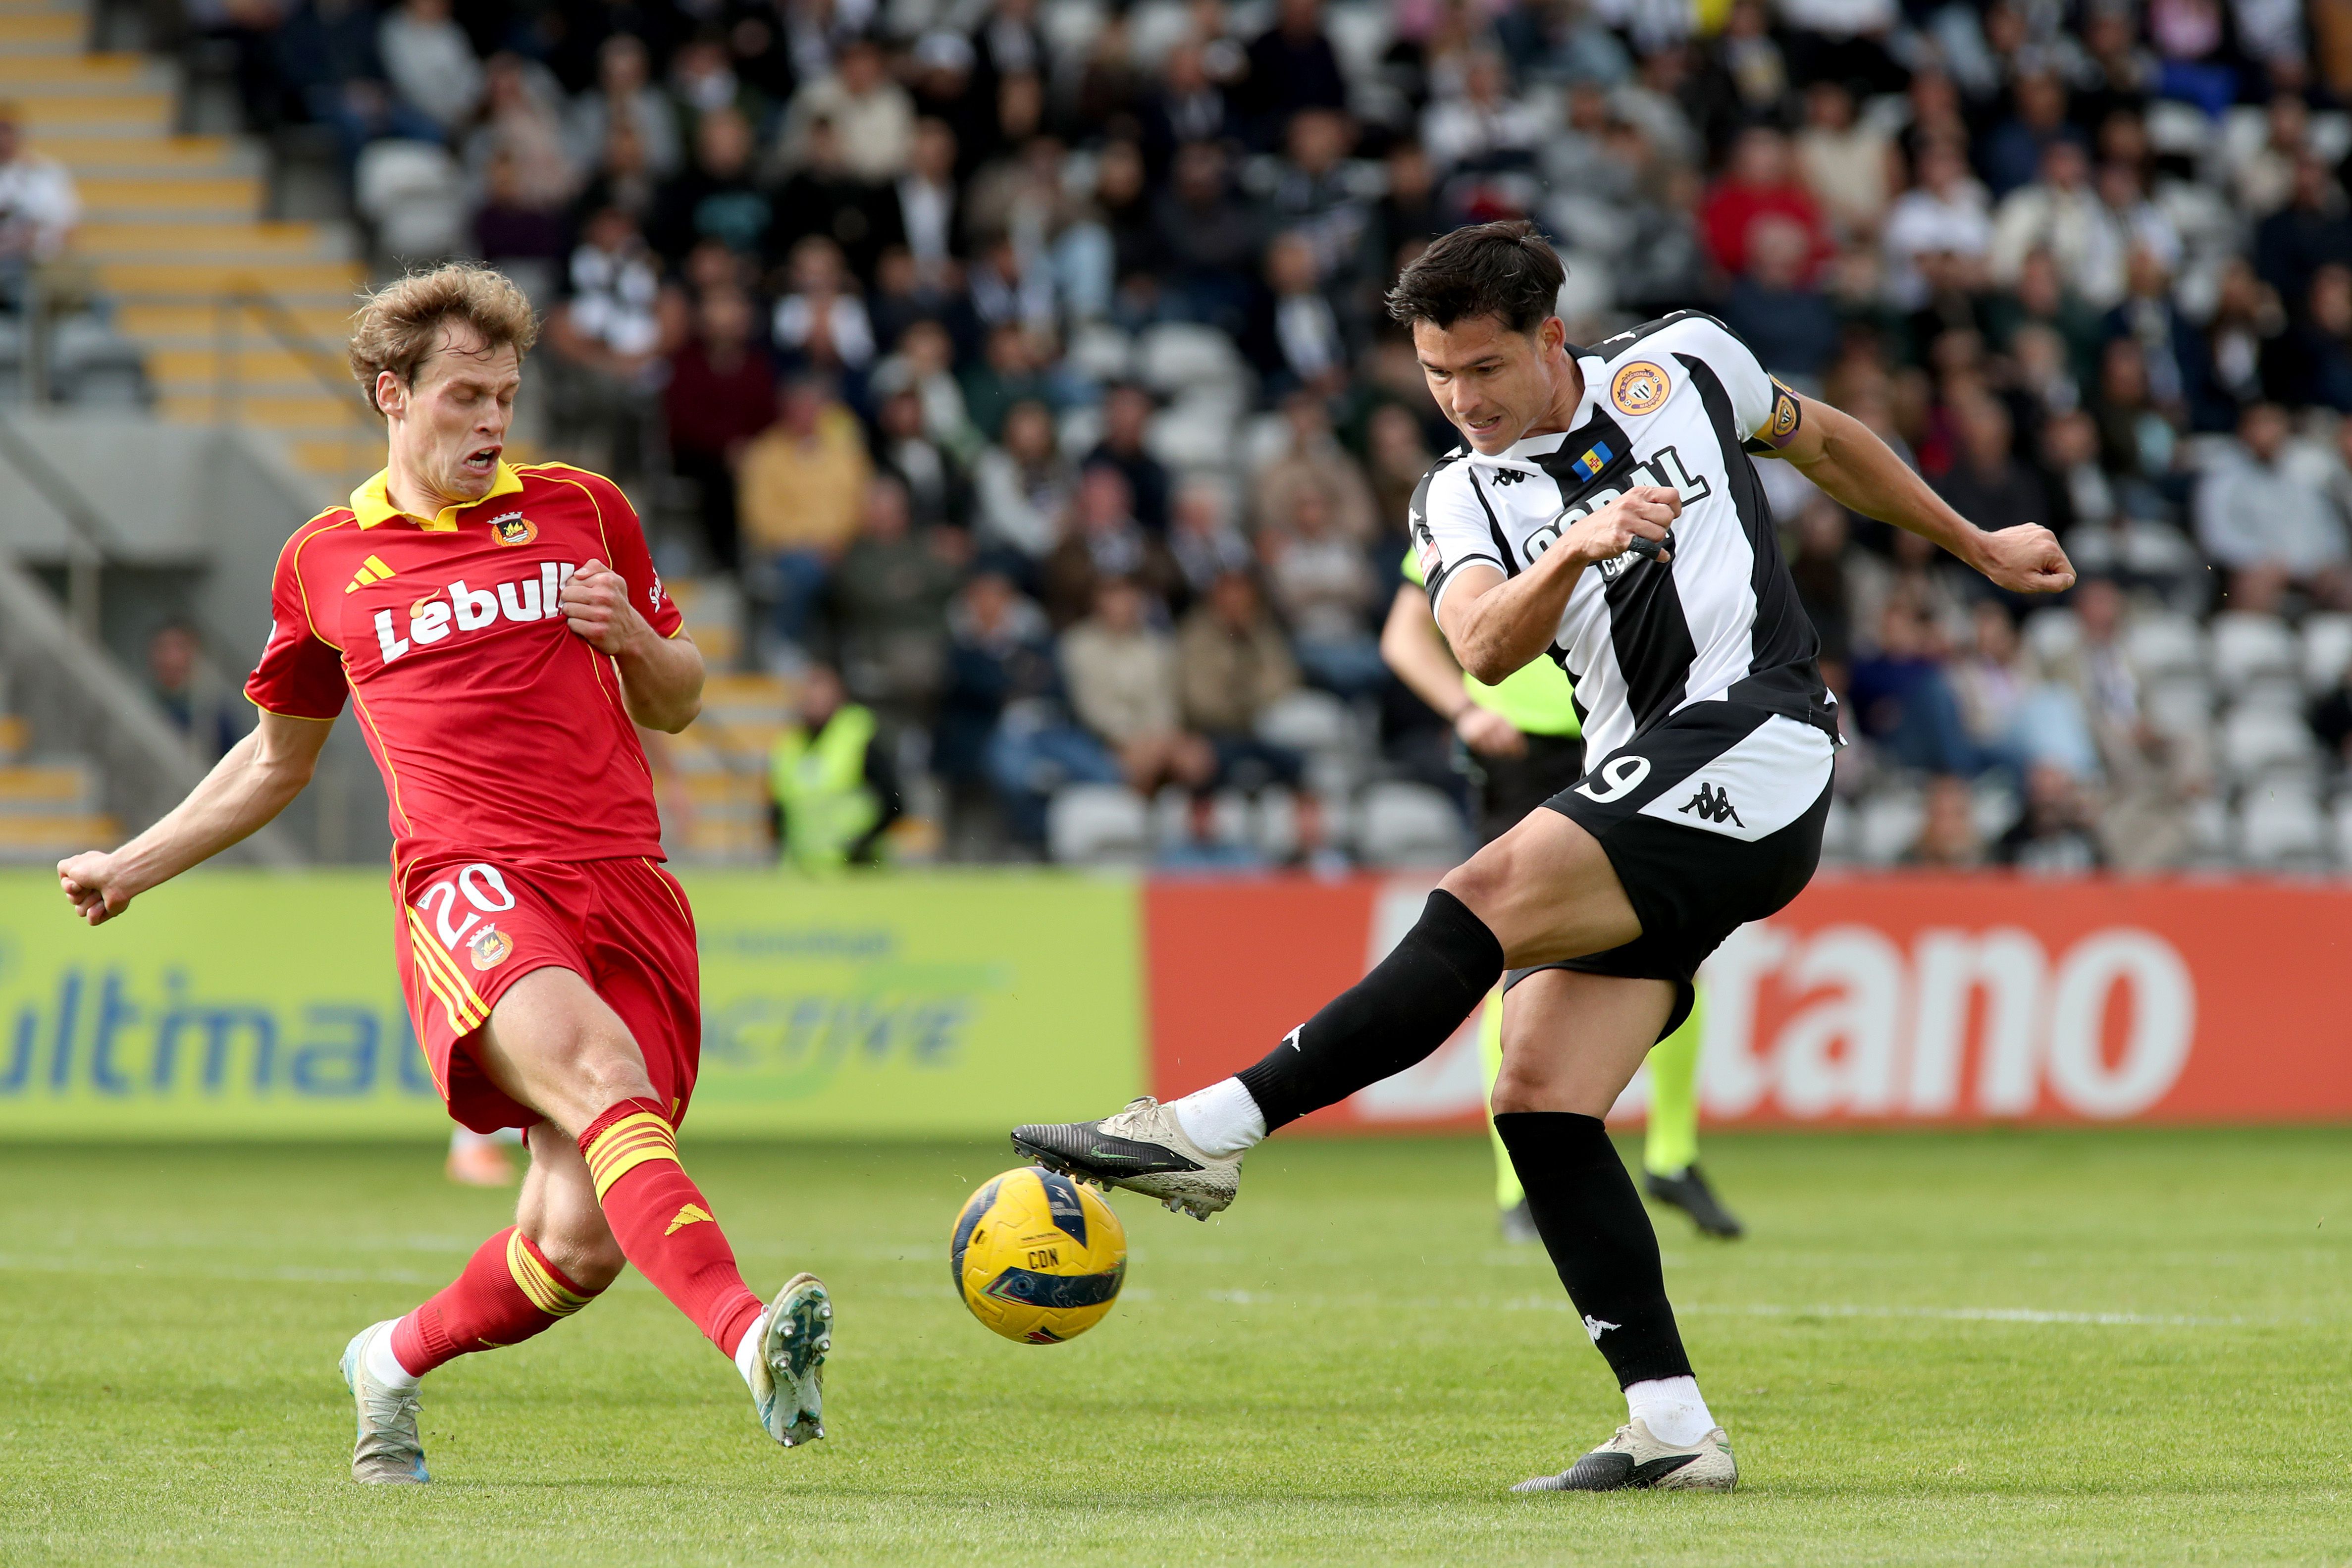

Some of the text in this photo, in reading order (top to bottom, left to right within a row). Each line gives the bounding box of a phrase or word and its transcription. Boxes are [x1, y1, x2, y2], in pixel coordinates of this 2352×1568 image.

[1624, 372, 1650, 383] NACIONAL
[1639, 391, 1661, 408] MADEIRA
[1574, 755, 1651, 803] 9
[416, 863, 516, 951] 20
[1028, 1248, 1059, 1269] CDN
